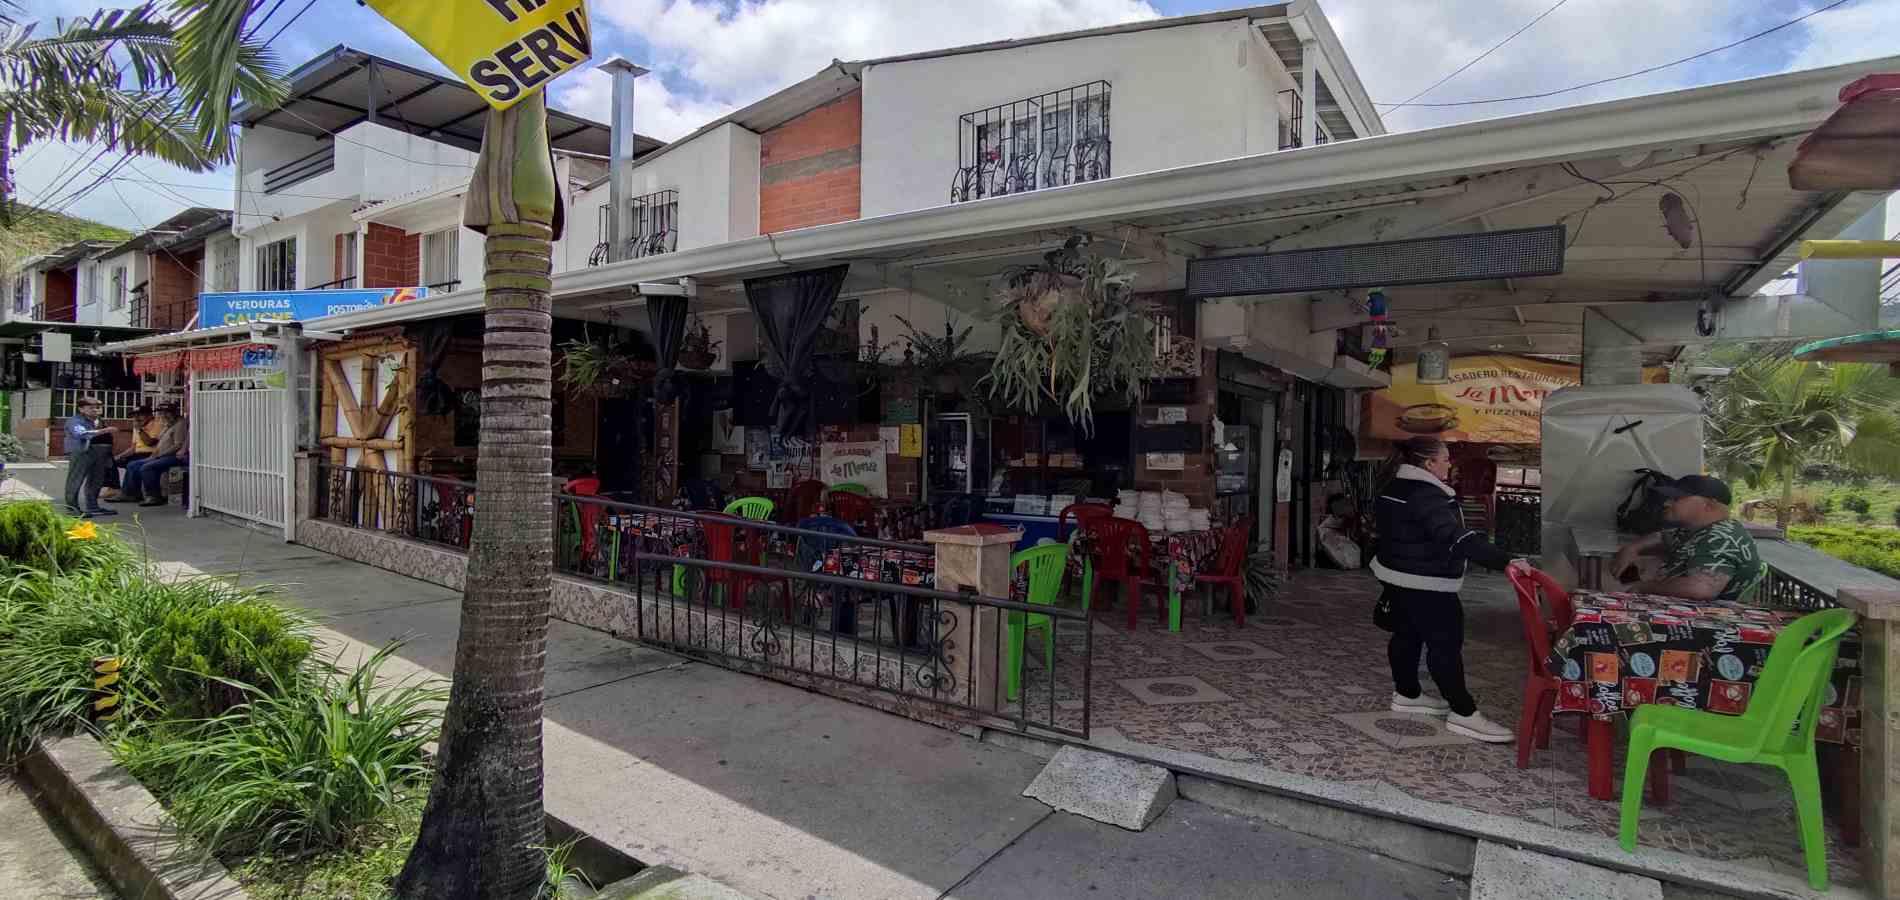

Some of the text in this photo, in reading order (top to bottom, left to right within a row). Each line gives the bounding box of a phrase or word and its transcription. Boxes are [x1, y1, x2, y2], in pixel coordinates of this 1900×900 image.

[470, 7, 590, 101] SERV
[227, 299, 290, 309] VERDURAS
[1455, 386, 1483, 402] La
